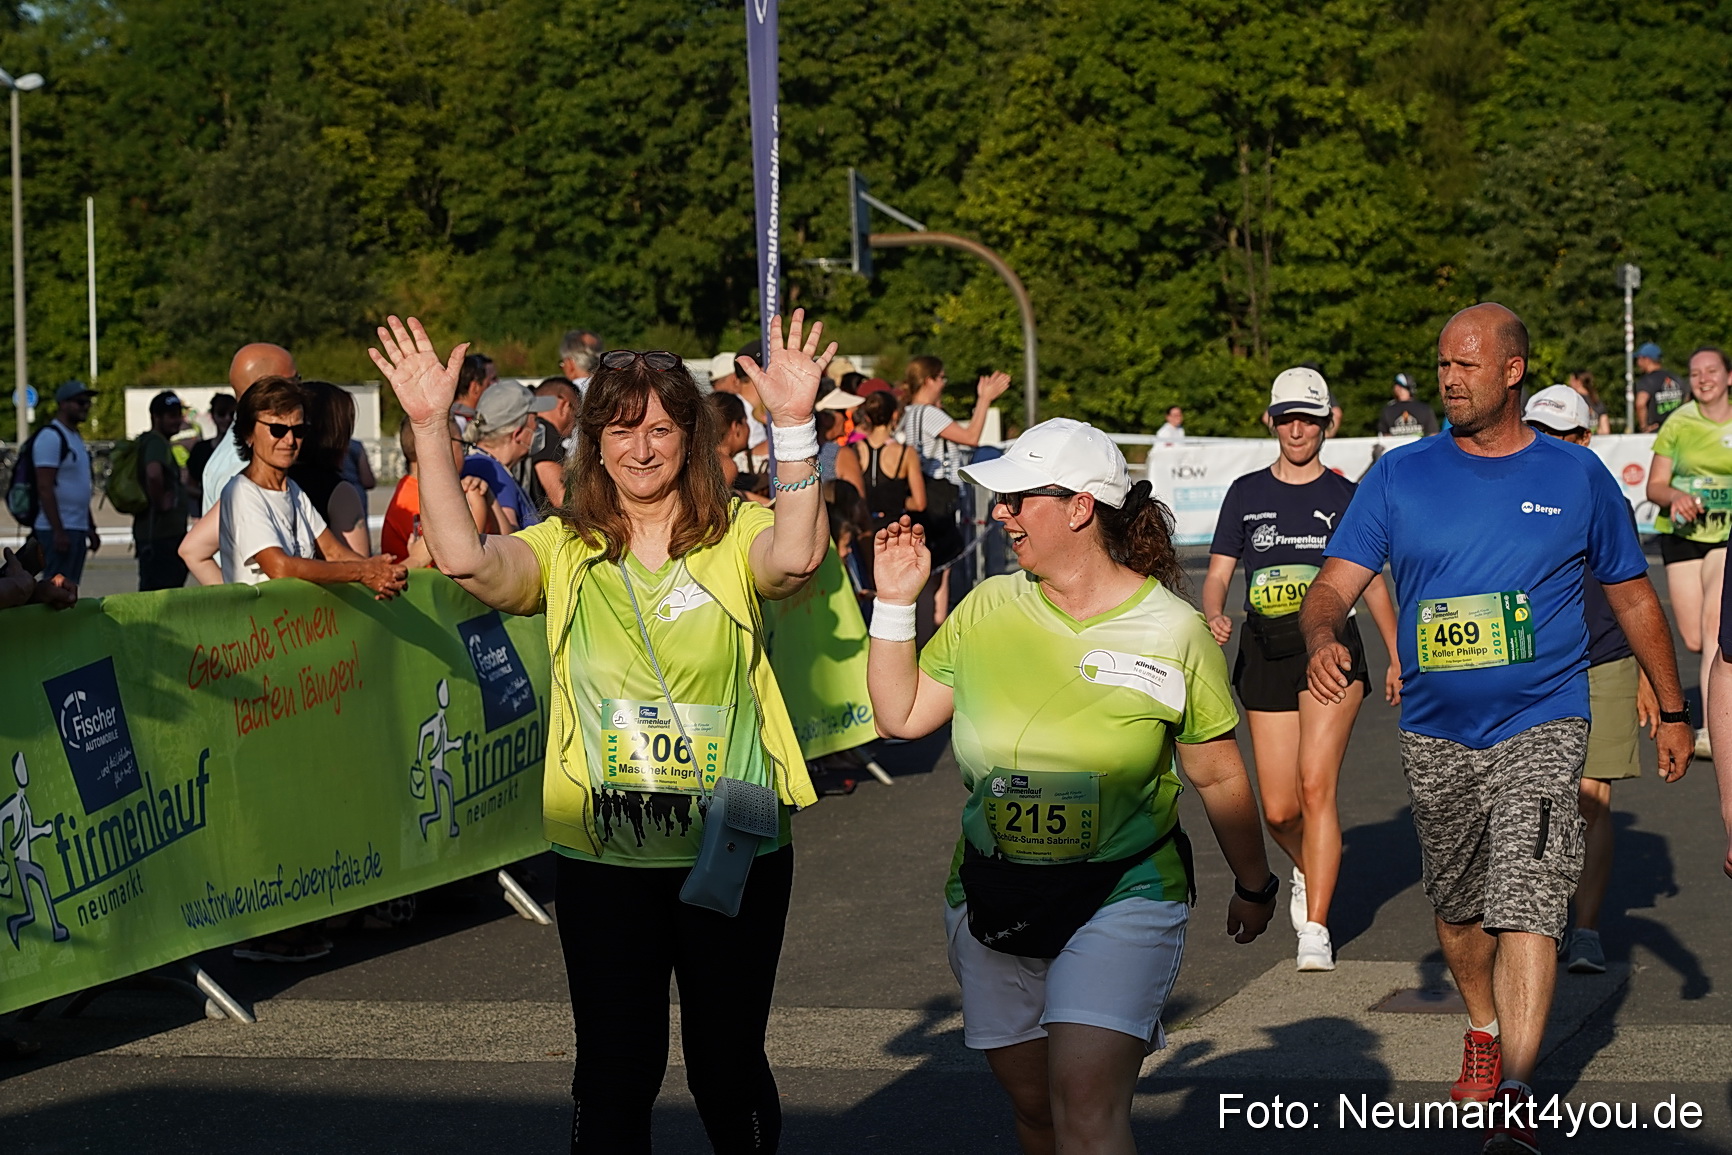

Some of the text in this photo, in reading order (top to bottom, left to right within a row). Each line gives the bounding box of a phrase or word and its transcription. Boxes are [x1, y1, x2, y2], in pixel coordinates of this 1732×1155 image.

[1535, 504, 1562, 516] Berger
[1275, 535, 1328, 545] Firmenlauf
[1262, 583, 1308, 603] 1790
[188, 607, 339, 690] Gesunde Firmen
[1420, 628, 1429, 662] WALK
[1434, 621, 1480, 647] 469
[1491, 622, 1503, 655] 2022
[477, 646, 508, 673] Fischer
[1135, 660, 1168, 677] Klinikum
[1431, 647, 1488, 658] Koller Philipp
[234, 640, 363, 737] laufen länger!
[72, 706, 117, 741] Fischer
[85, 729, 119, 753] AUTOMOBILE
[462, 695, 545, 798] firmenl
[608, 734, 618, 778] WALK
[629, 731, 694, 764] 206
[705, 742, 718, 783] 2022
[466, 777, 519, 826] neumarkt
[1006, 787, 1043, 795] Firmenlauf
[54, 747, 210, 891] firmenlauf
[1005, 801, 1067, 835] 215
[1081, 809, 1092, 850] 2022
[1046, 836, 1080, 846] Sabrina
[77, 868, 144, 927] neumarkt
